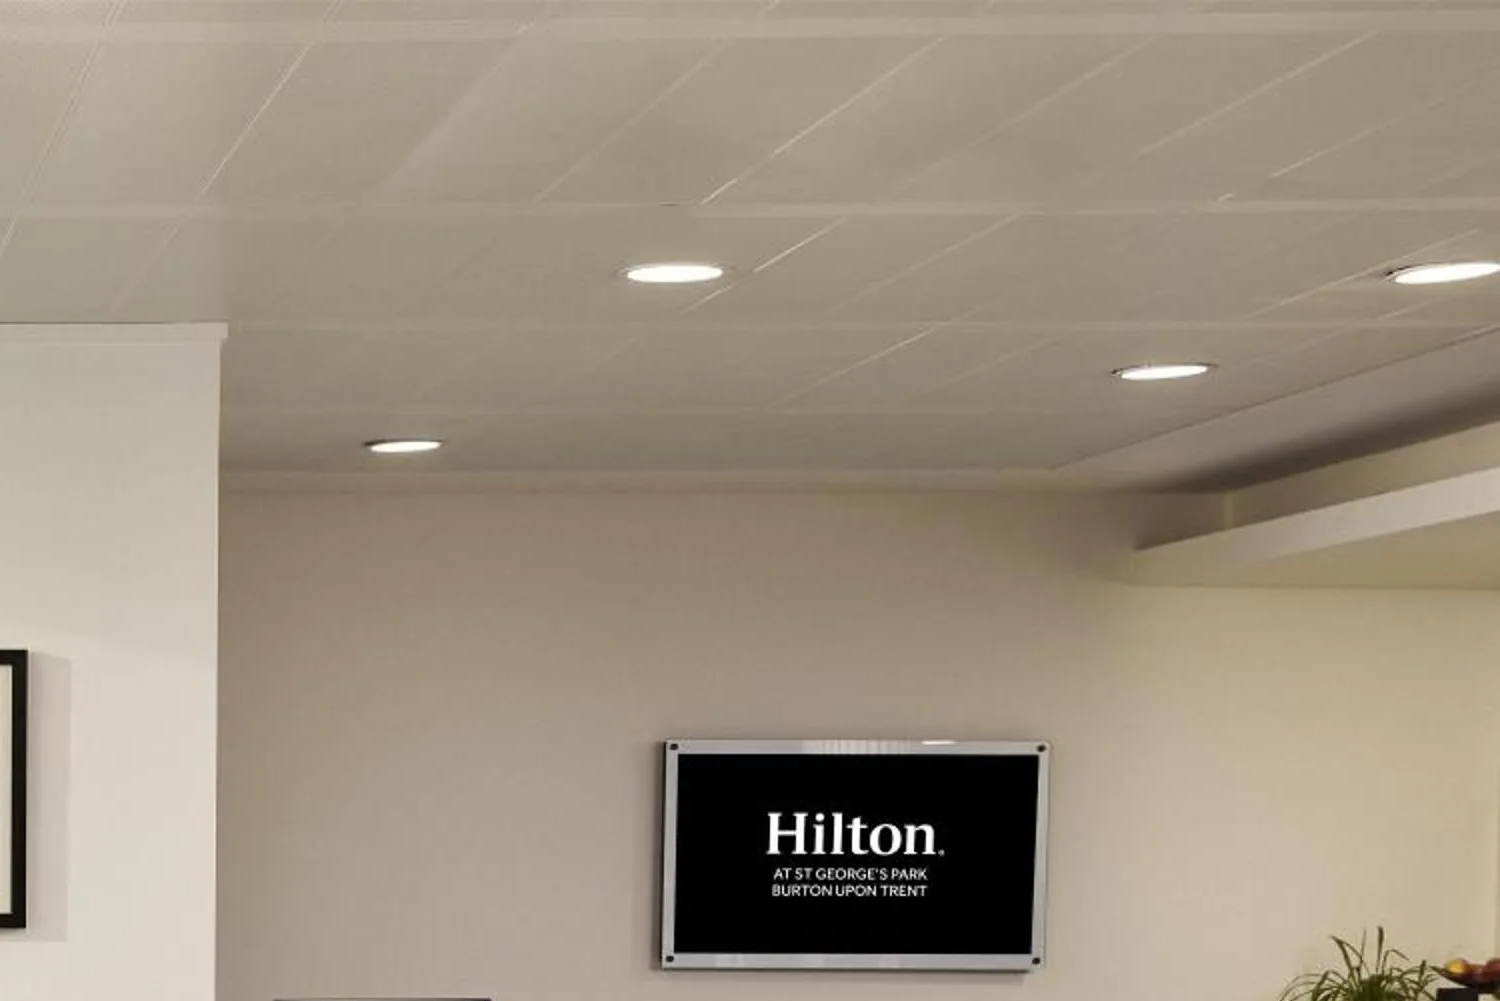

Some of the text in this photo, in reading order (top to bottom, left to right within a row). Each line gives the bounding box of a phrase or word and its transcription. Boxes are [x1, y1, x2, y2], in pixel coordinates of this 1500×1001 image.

[766, 811, 937, 856] Hilton
[773, 867, 929, 881] AT ST GEORGE'S PARK
[771, 884, 929, 897] BURTON UPON TRENT
